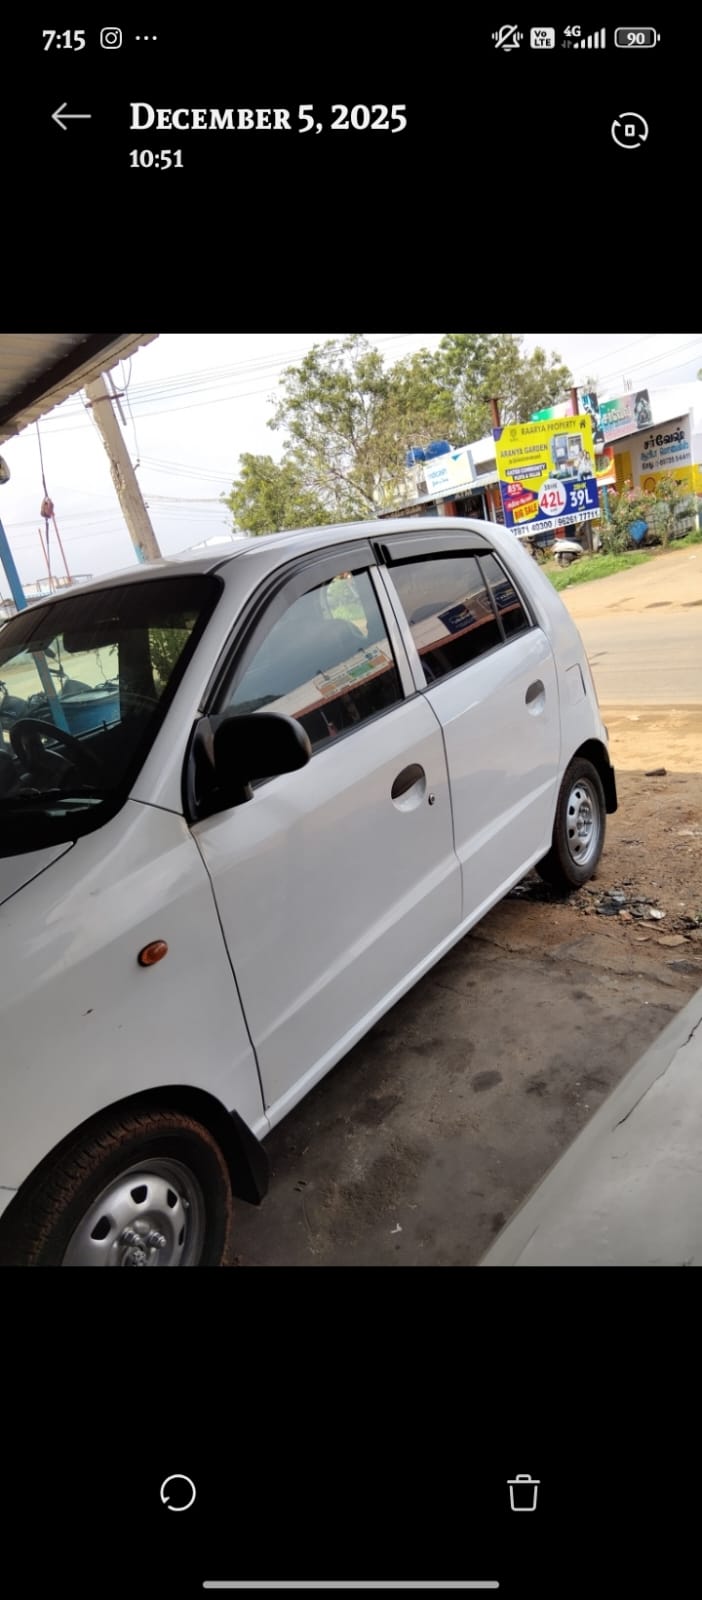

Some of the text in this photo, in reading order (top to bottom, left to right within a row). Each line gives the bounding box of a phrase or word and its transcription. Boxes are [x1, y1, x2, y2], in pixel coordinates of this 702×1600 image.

[547, 421, 576, 432] PROPERTY
[524, 444, 548, 454] GARDEN
[540, 491, 564, 509] 42L
[570, 489, 593, 507] 39L
[524, 502, 538, 516] SALE
